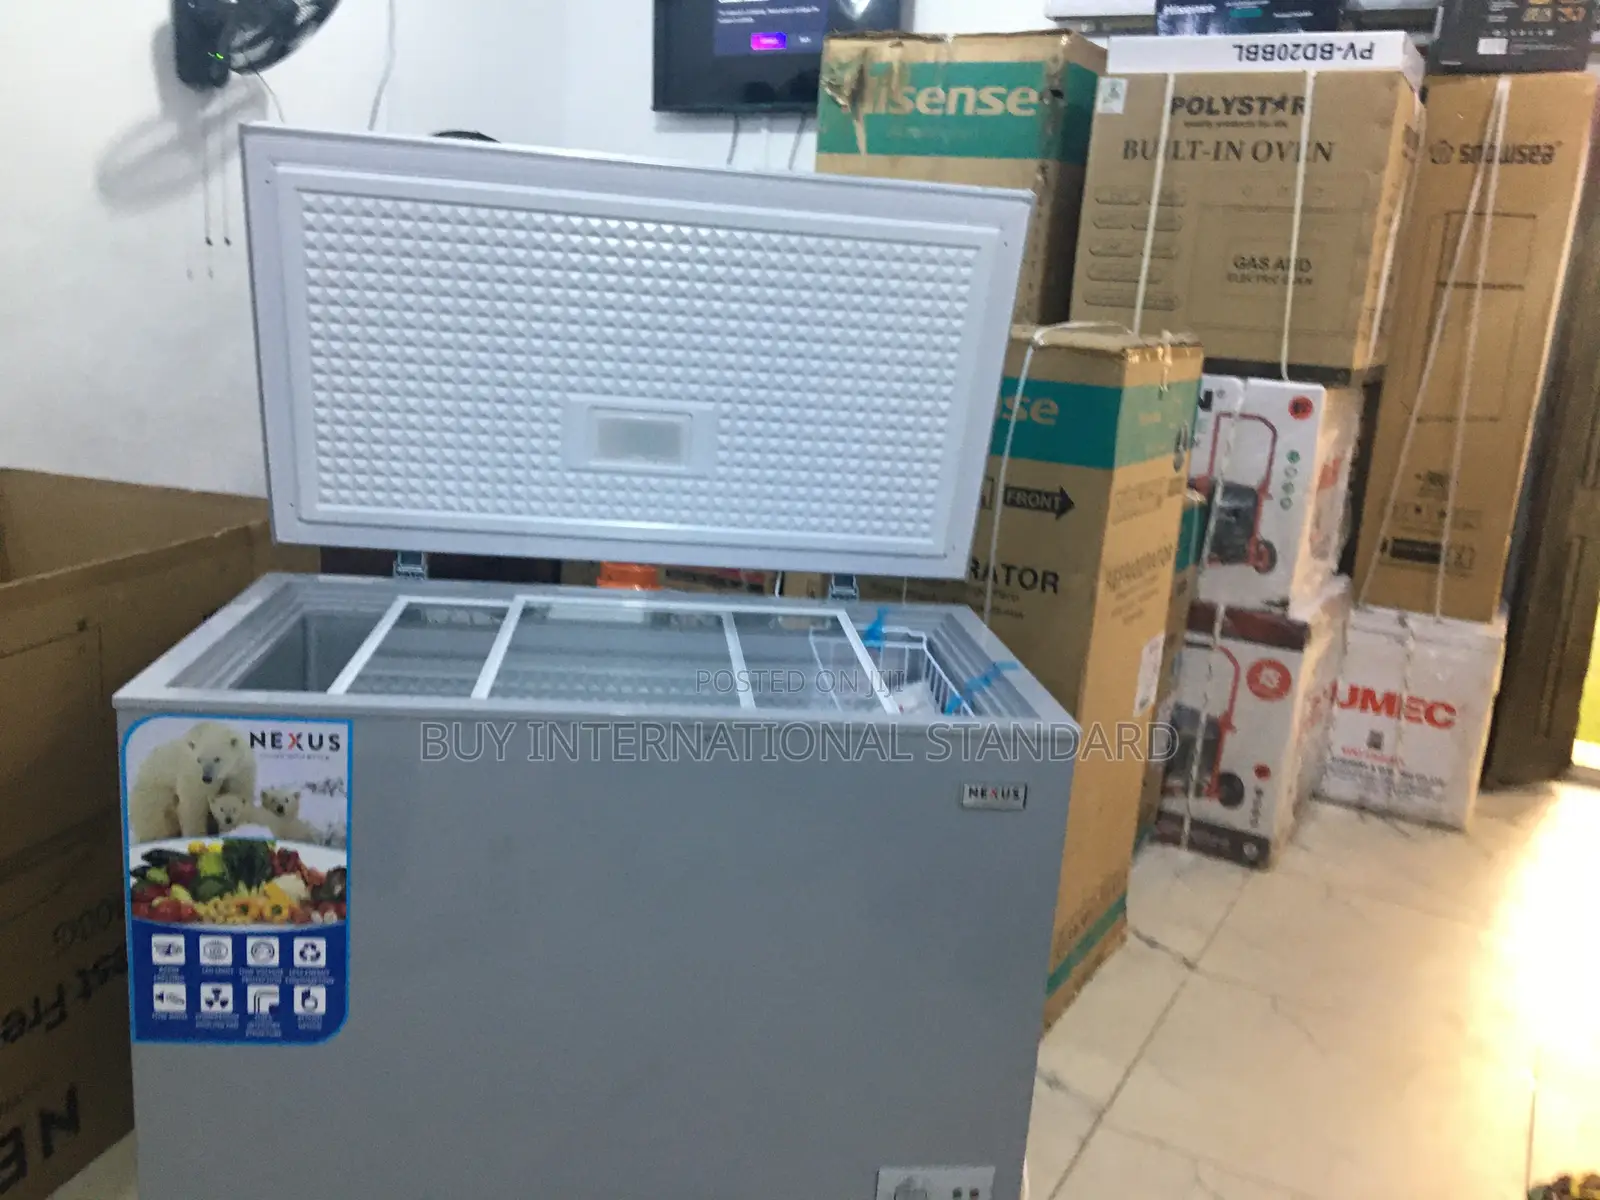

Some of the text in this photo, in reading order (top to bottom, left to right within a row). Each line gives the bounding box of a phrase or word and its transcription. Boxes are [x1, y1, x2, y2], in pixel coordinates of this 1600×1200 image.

[1233, 41, 1376, 63] PV-BD20BBL
[1123, 139, 1246, 163] BULT-IN
[998, 394, 1059, 425] se
[1006, 489, 1060, 511] FRONT
[249, 730, 341, 753] NEXUS
[968, 785, 1020, 801] NEXUS
